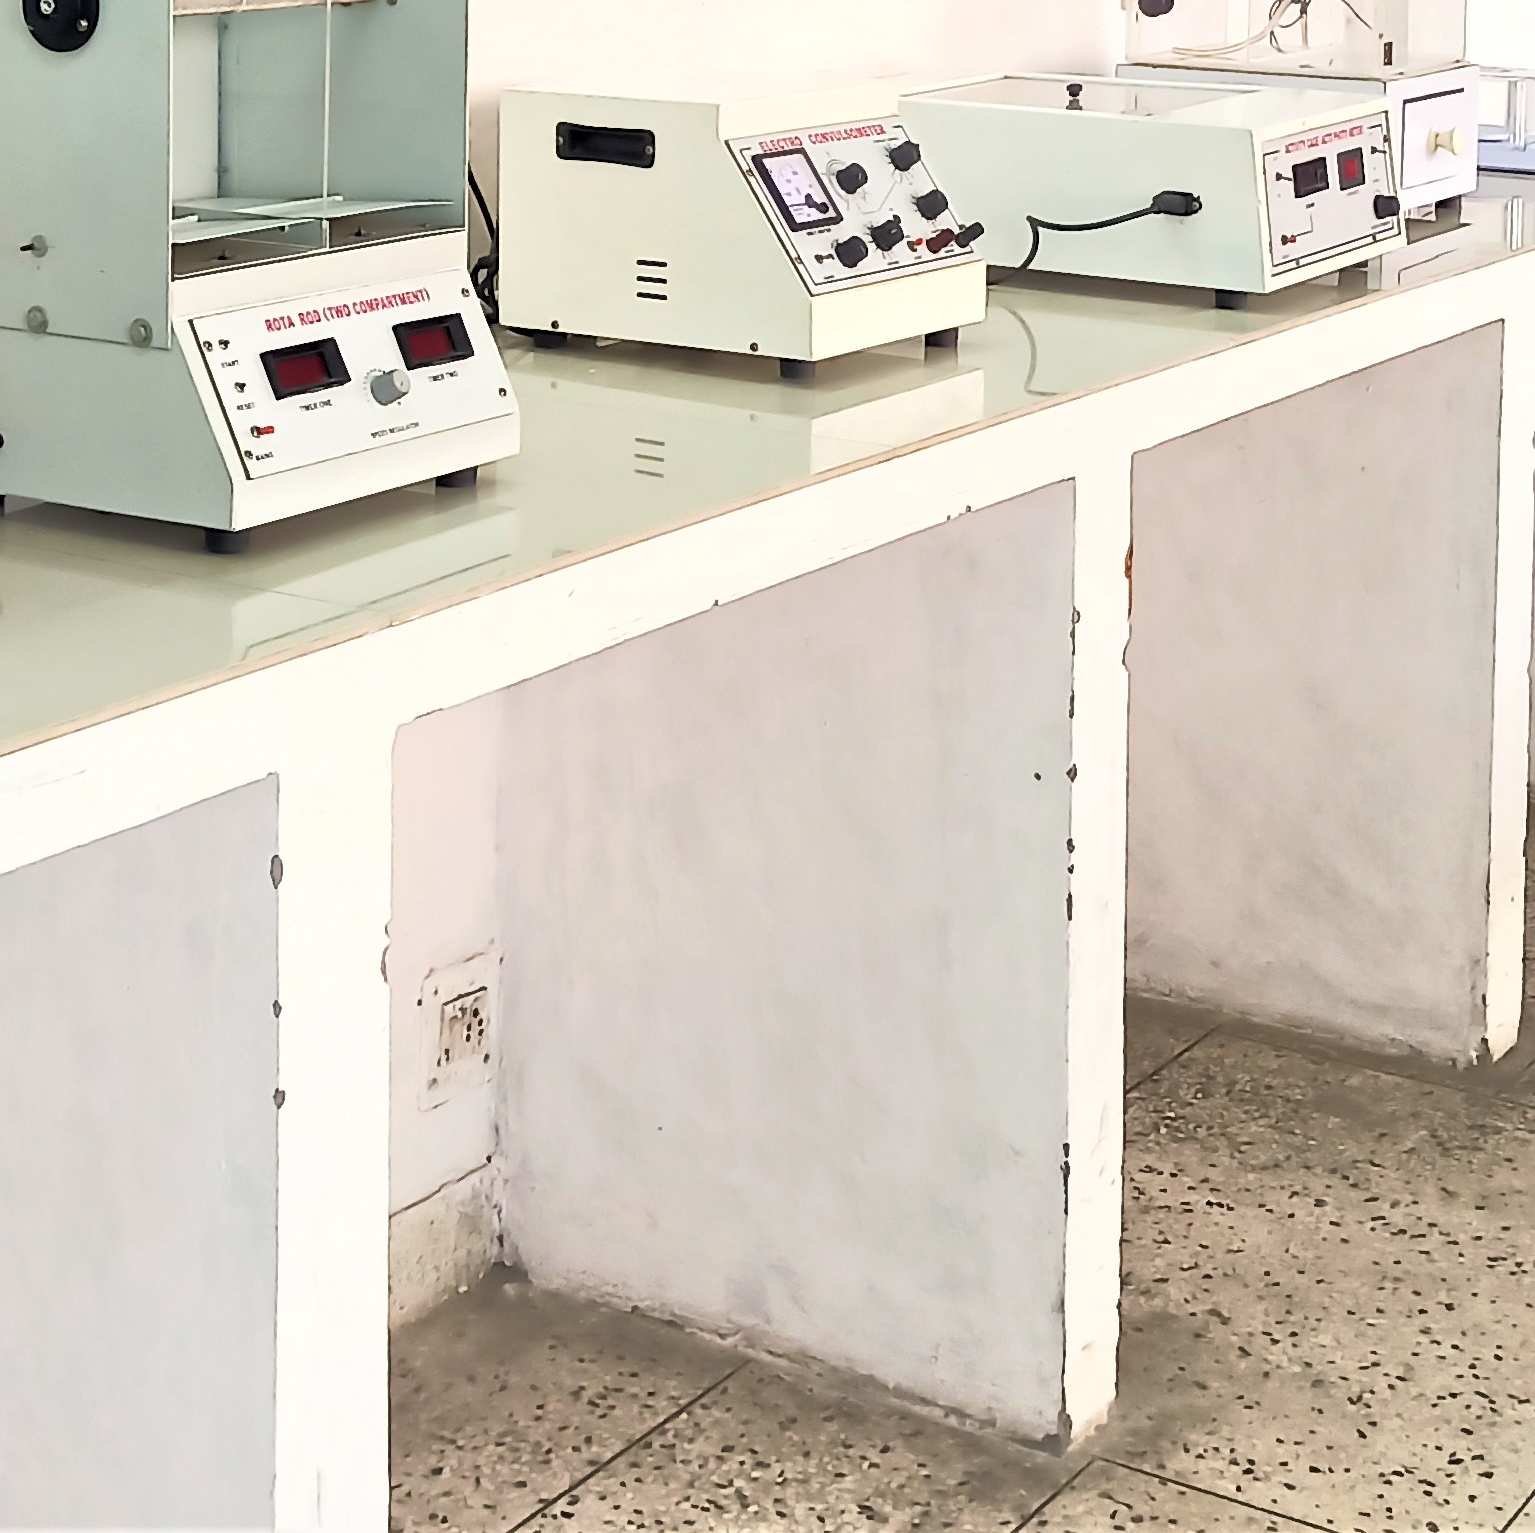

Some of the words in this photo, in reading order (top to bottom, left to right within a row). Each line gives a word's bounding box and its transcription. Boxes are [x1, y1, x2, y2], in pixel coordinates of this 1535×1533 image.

[758, 136, 803, 152] ELECTRO
[265, 315, 295, 332] ROTA
[298, 310, 322, 326] ROD
[323, 304, 351, 322] (TWO
[352, 288, 430, 315] COMPARTMENT)
